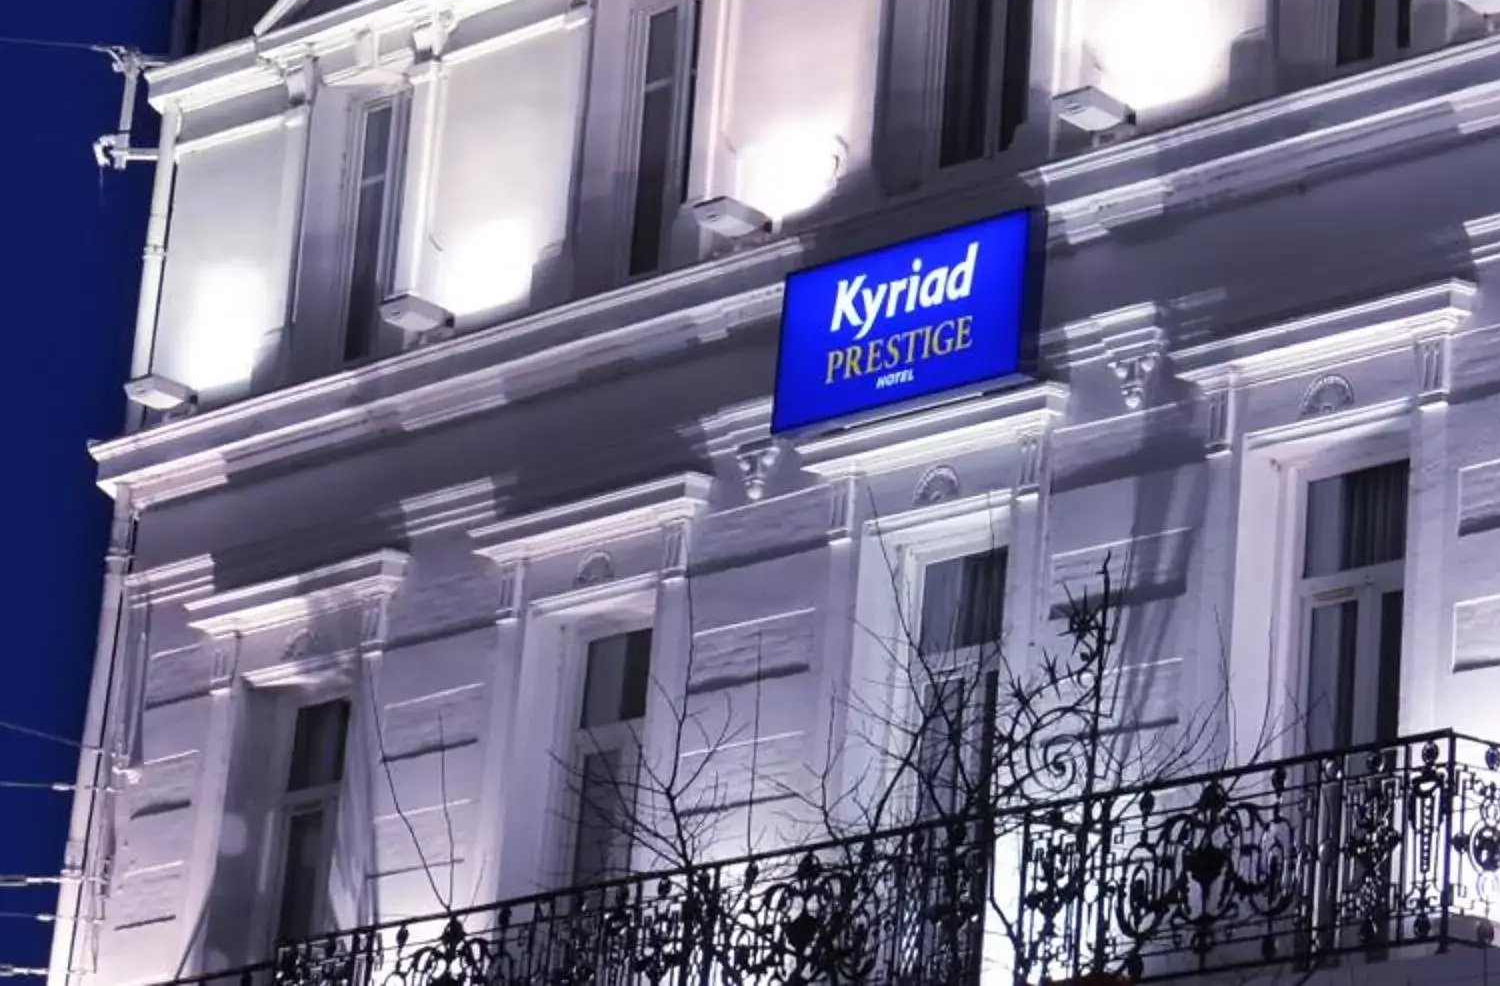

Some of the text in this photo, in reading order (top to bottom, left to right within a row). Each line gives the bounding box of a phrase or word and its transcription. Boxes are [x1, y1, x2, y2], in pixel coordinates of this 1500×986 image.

[830, 241, 979, 340] Kyriad
[825, 315, 973, 384] PRESTIGE
[876, 369, 914, 389] HOTEL
